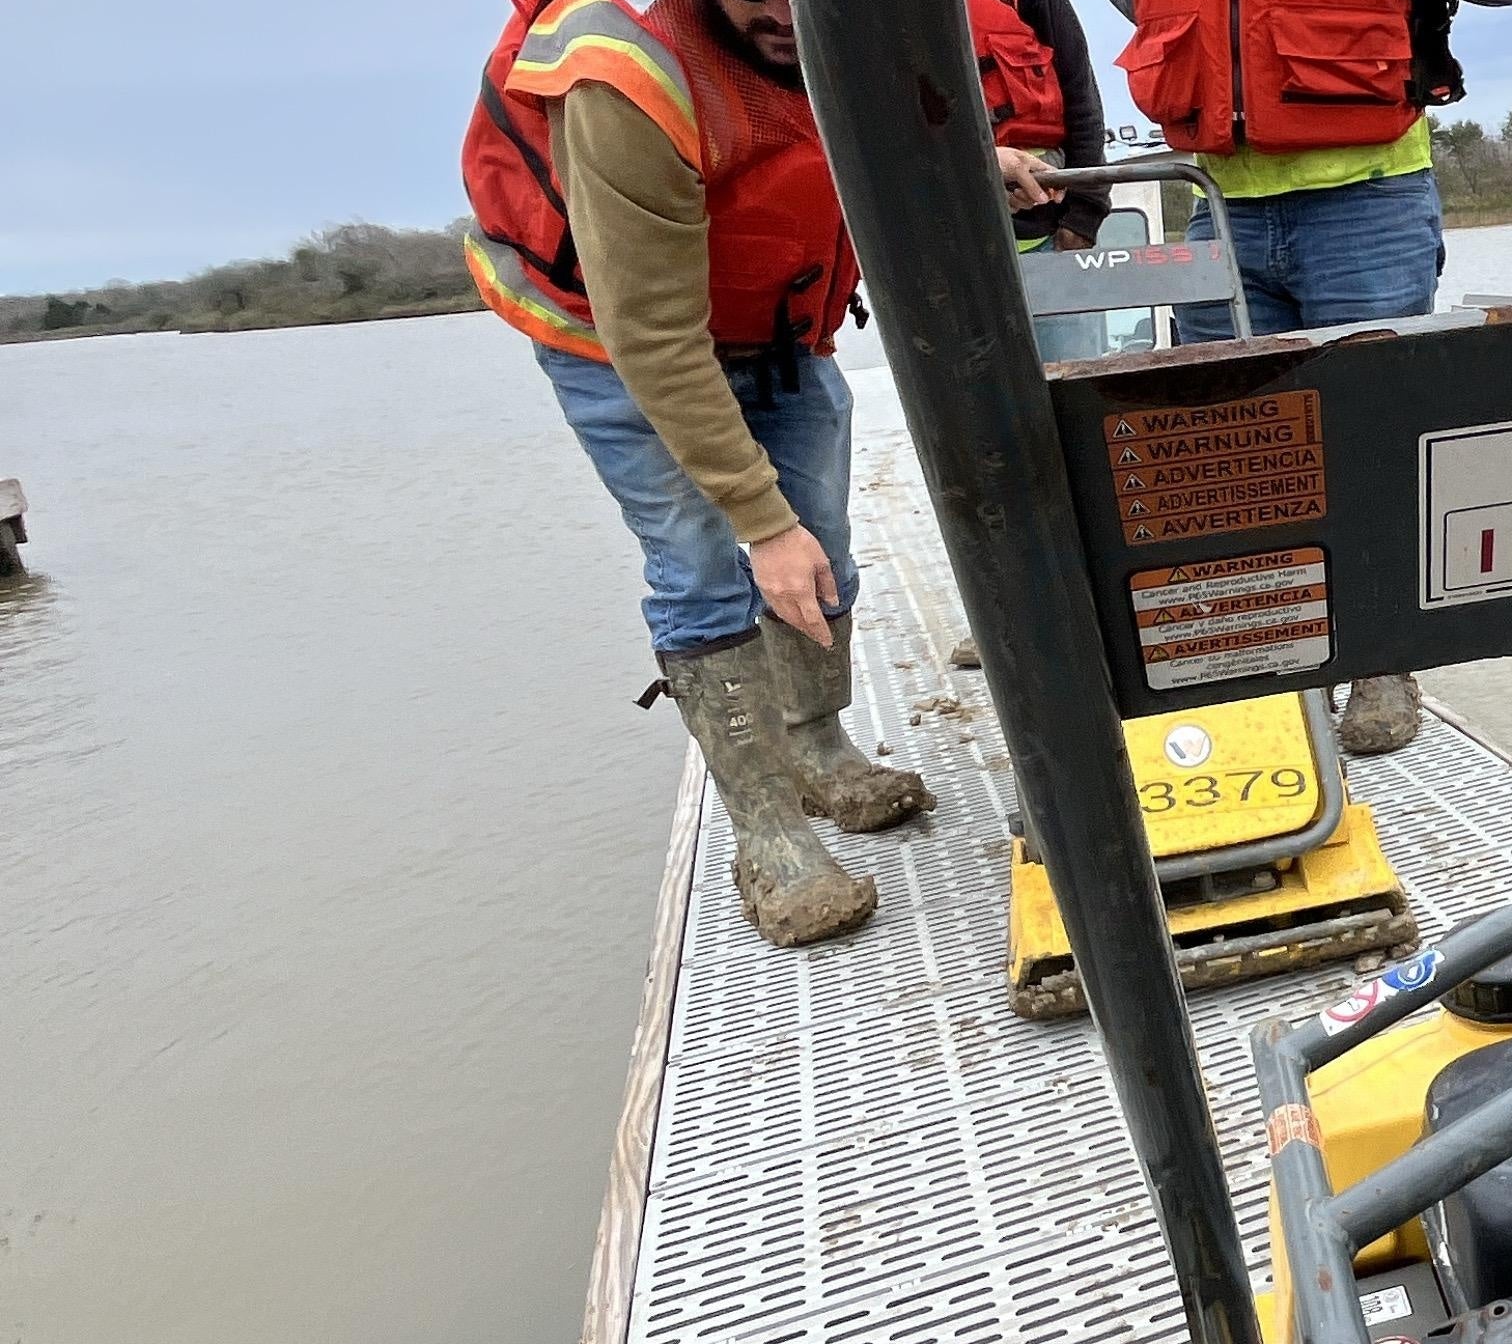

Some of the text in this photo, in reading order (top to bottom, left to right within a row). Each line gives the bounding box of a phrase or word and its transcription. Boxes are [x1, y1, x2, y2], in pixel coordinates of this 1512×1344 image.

[1142, 399, 1280, 433] WARNING
[1146, 424, 1294, 460] WARNUNG
[1153, 449, 1317, 487] ADVERTENCIA
[1158, 473, 1320, 512] ADVERTISSEMENT
[1162, 499, 1322, 537] AVVERTENZA
[1193, 552, 1294, 578] WARNING
[1141, 586, 1179, 599] Cancer
[1182, 583, 1202, 593] and
[1205, 572, 1275, 590] Reproductive
[1174, 621, 1326, 656] AVERTISSEMENT
[1139, 768, 1307, 813] 3379
